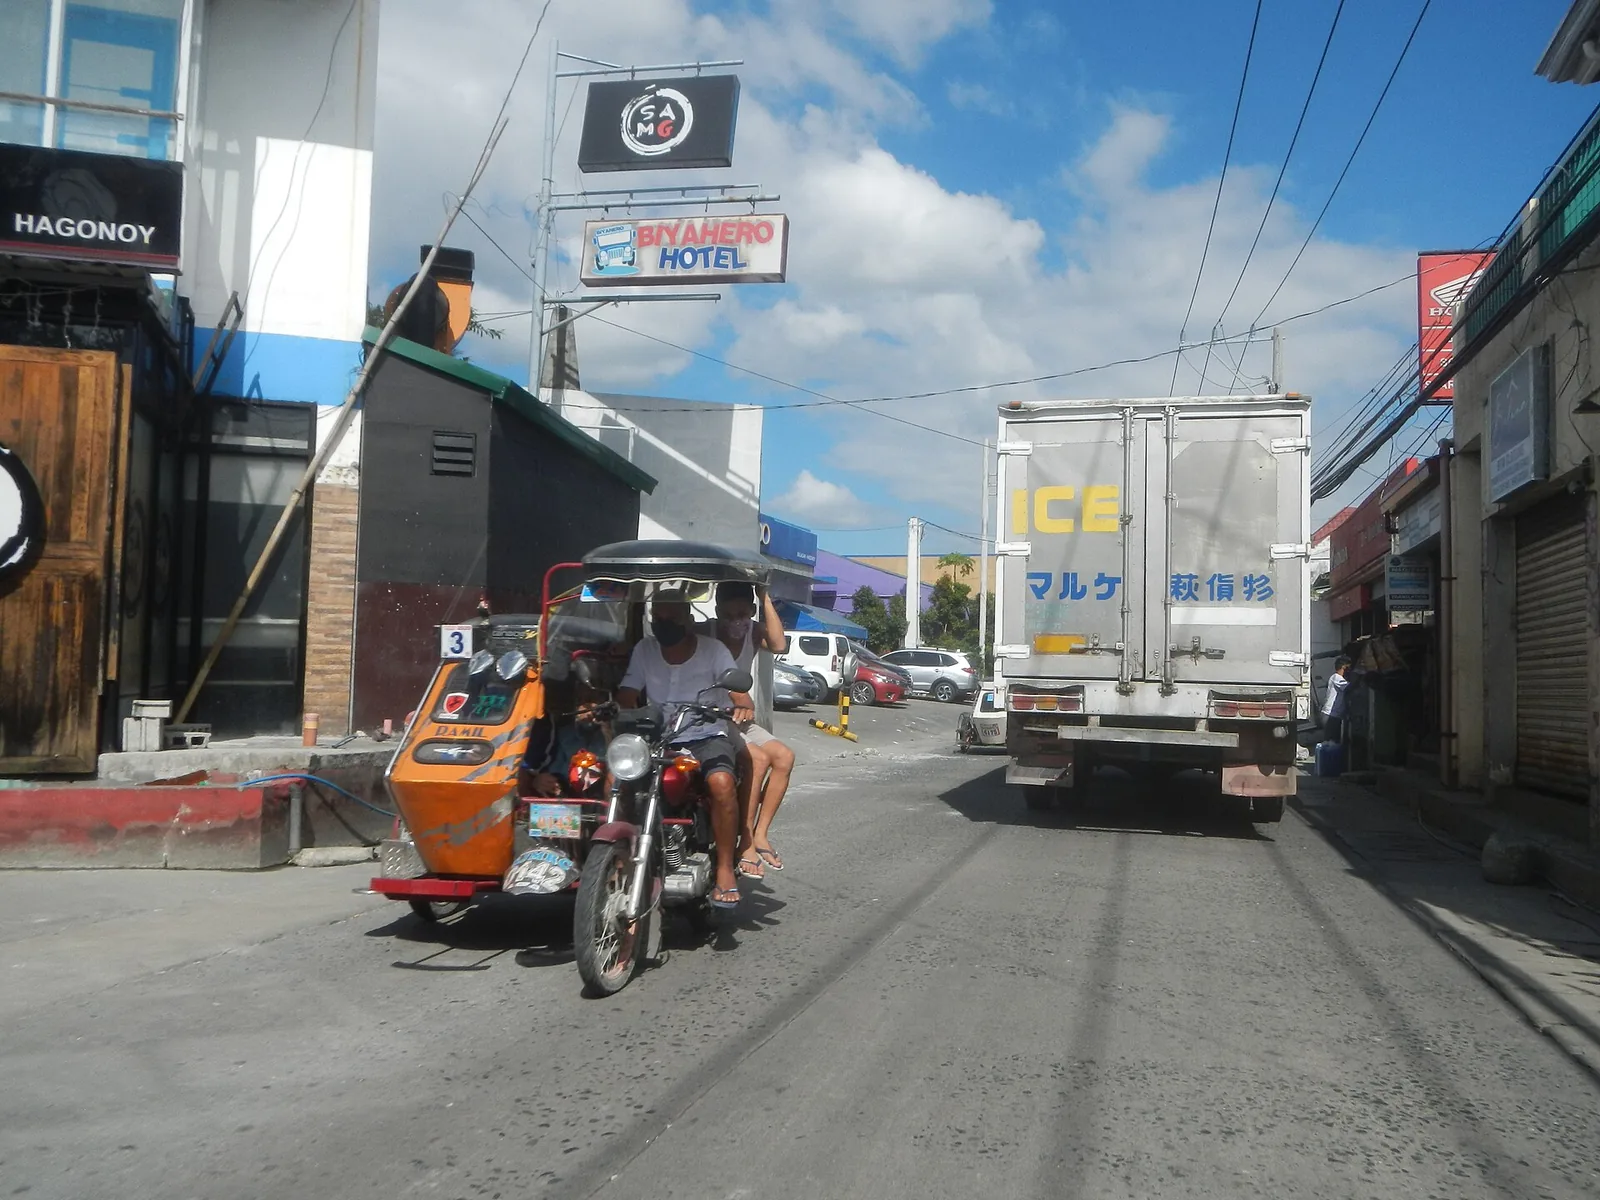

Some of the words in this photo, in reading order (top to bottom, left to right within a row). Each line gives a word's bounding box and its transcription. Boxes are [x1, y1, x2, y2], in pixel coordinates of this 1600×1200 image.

[14, 213, 155, 244] HAGONOY
[636, 221, 775, 248] BIYAHERO
[658, 246, 748, 270] HOTEL
[1012, 484, 1120, 535] ICE
[1026, 572, 1122, 600] マルケ
[450, 631, 464, 654] 3
